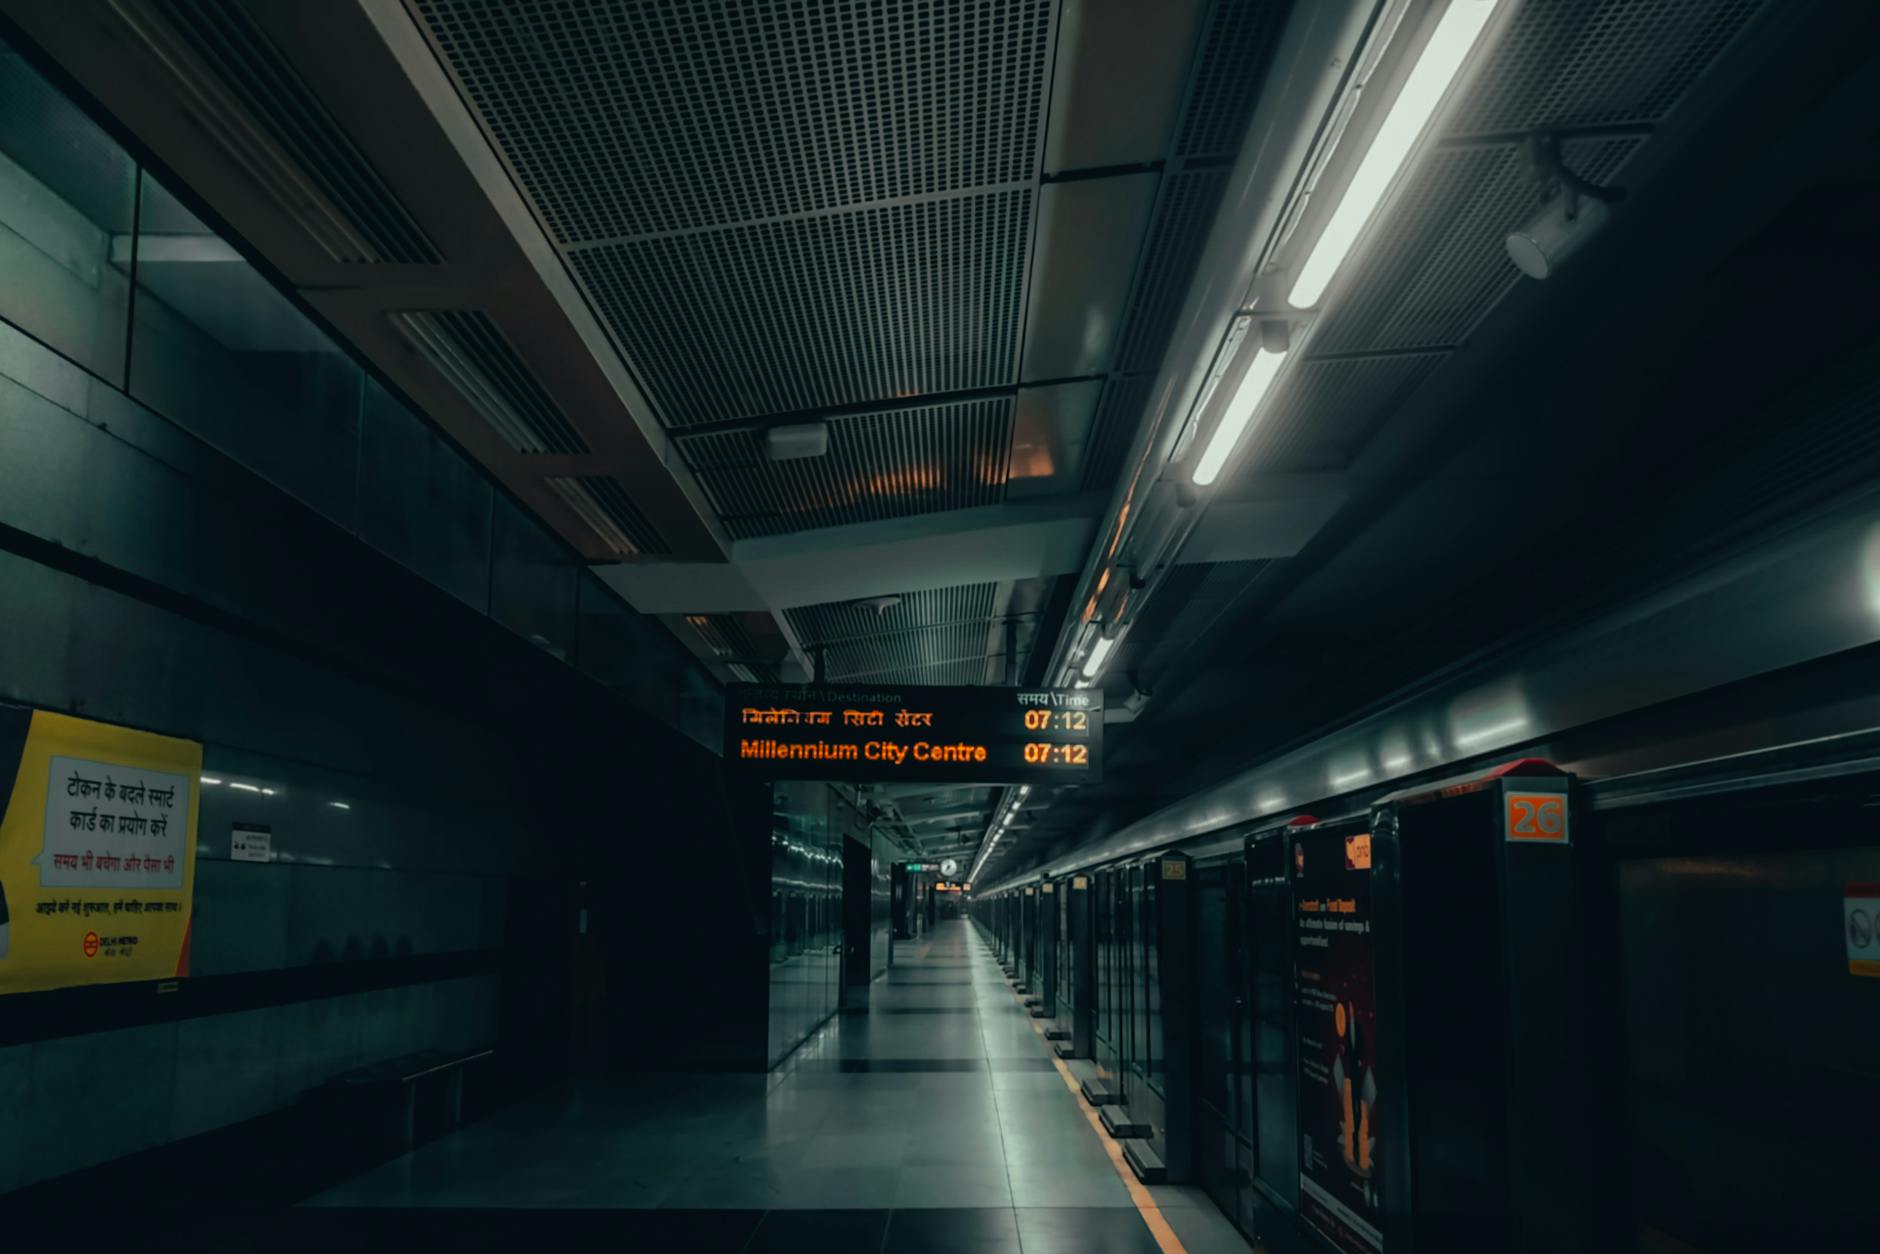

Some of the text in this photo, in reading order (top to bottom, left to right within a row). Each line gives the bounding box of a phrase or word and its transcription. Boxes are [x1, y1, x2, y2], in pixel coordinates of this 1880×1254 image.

[842, 708, 885, 727] सिटी
[1024, 708, 1087, 730] 07:12
[740, 738, 989, 765] Millennium City Centre
[1024, 742, 1088, 764] 07:12
[67, 770, 175, 808] टोकन के बदले स्मार्ट
[70, 807, 169, 837] कार्ड का प्रयोग करें
[1513, 800, 1562, 834] 26
[53, 854, 79, 871] समय
[81, 850, 94, 871] भी
[122, 853, 142, 872] और
[163, 854, 175, 873] भी
